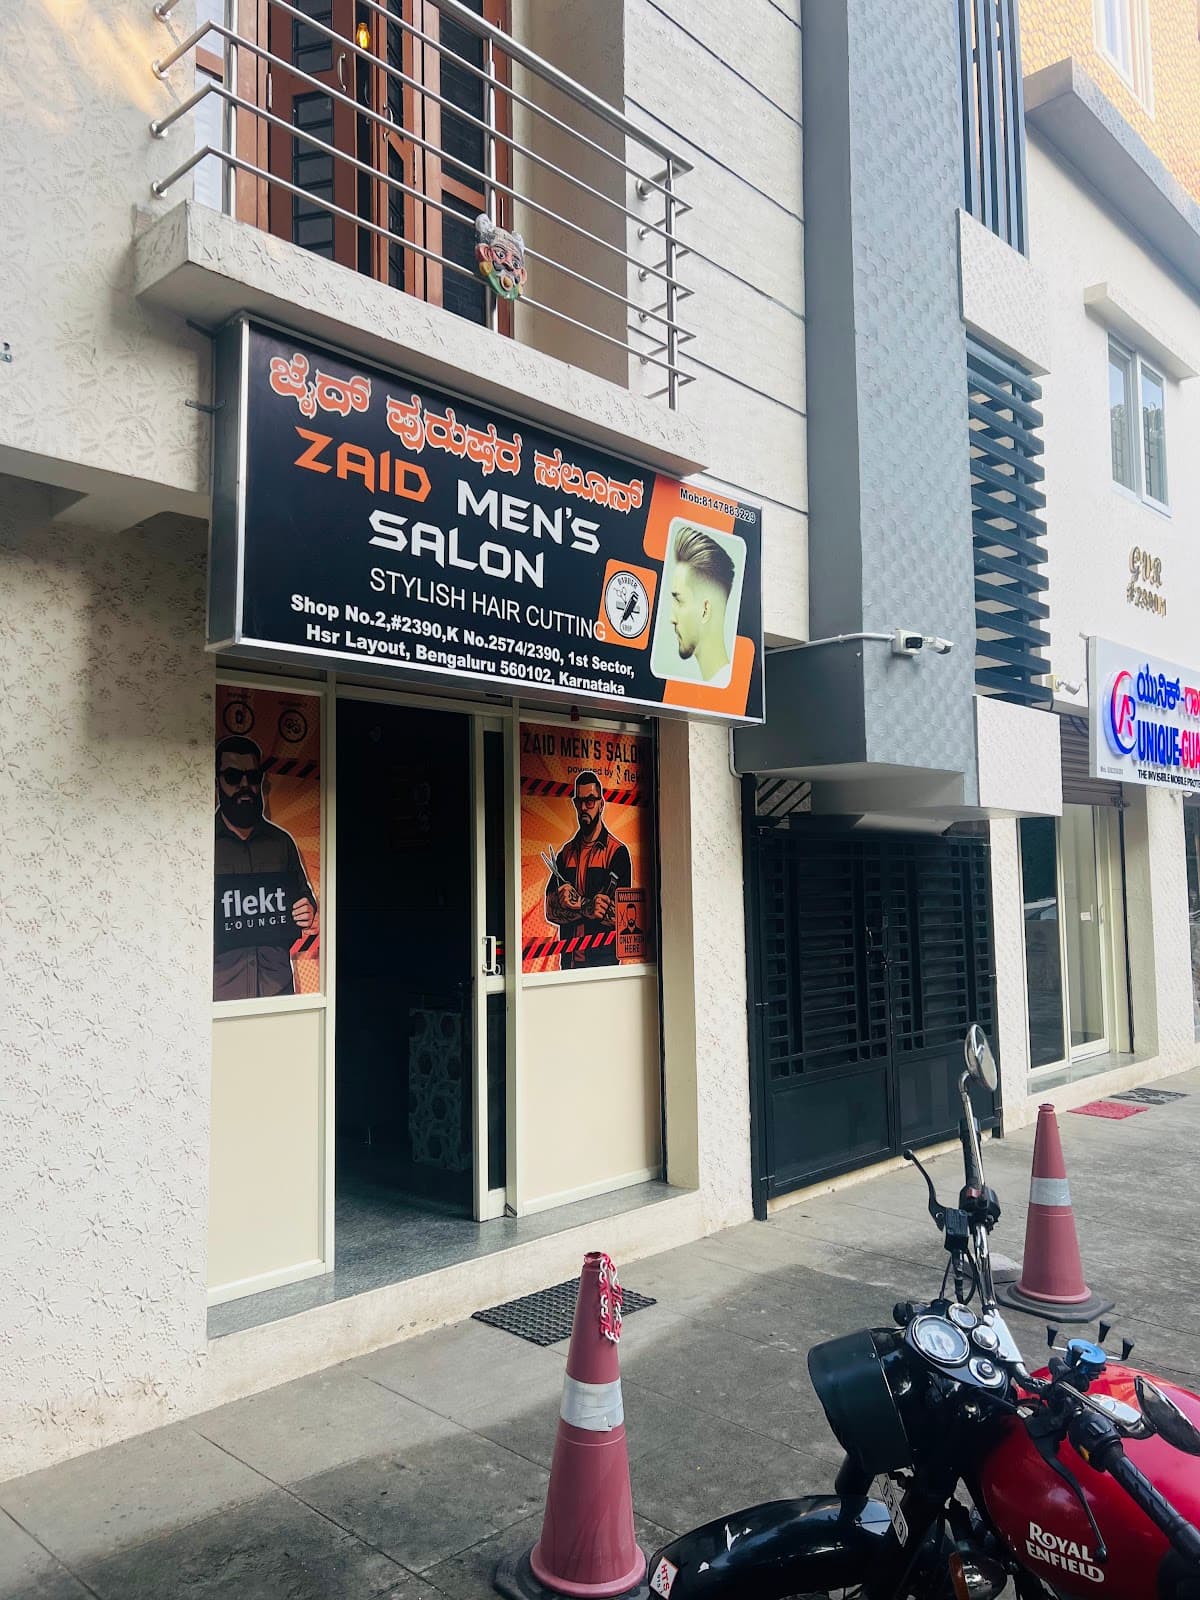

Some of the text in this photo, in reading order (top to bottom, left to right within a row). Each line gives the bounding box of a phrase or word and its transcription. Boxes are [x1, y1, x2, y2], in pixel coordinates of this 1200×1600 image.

[387, 394, 523, 477] ಪುರುಷರ
[534, 448, 644, 515] ಸಲೂನ್
[294, 426, 600, 554] ZAID MEN'S
[368, 509, 544, 589] SALON
[370, 567, 606, 642] STYLISH HAIR CUTTING
[290, 594, 339, 621] Shop
[464, 629, 564, 667] No.2574/2390,
[568, 652, 588, 668] 1st
[591, 656, 635, 679] Sector,
[306, 623, 625, 695] Hsr Layout, Bengaluru 560102, Karnataka
[523, 733, 640, 764] ZAID MEN'S SALO
[604, 767, 613, 778] by
[1138, 769, 1148, 780] THE
[221, 887, 287, 918] flekt
[225, 915, 287, 931] LOUNGE
[624, 944, 640, 954] HERE
[1025, 1539, 1105, 1583] ENFIELD
[1029, 1521, 1094, 1563] ROYAL
